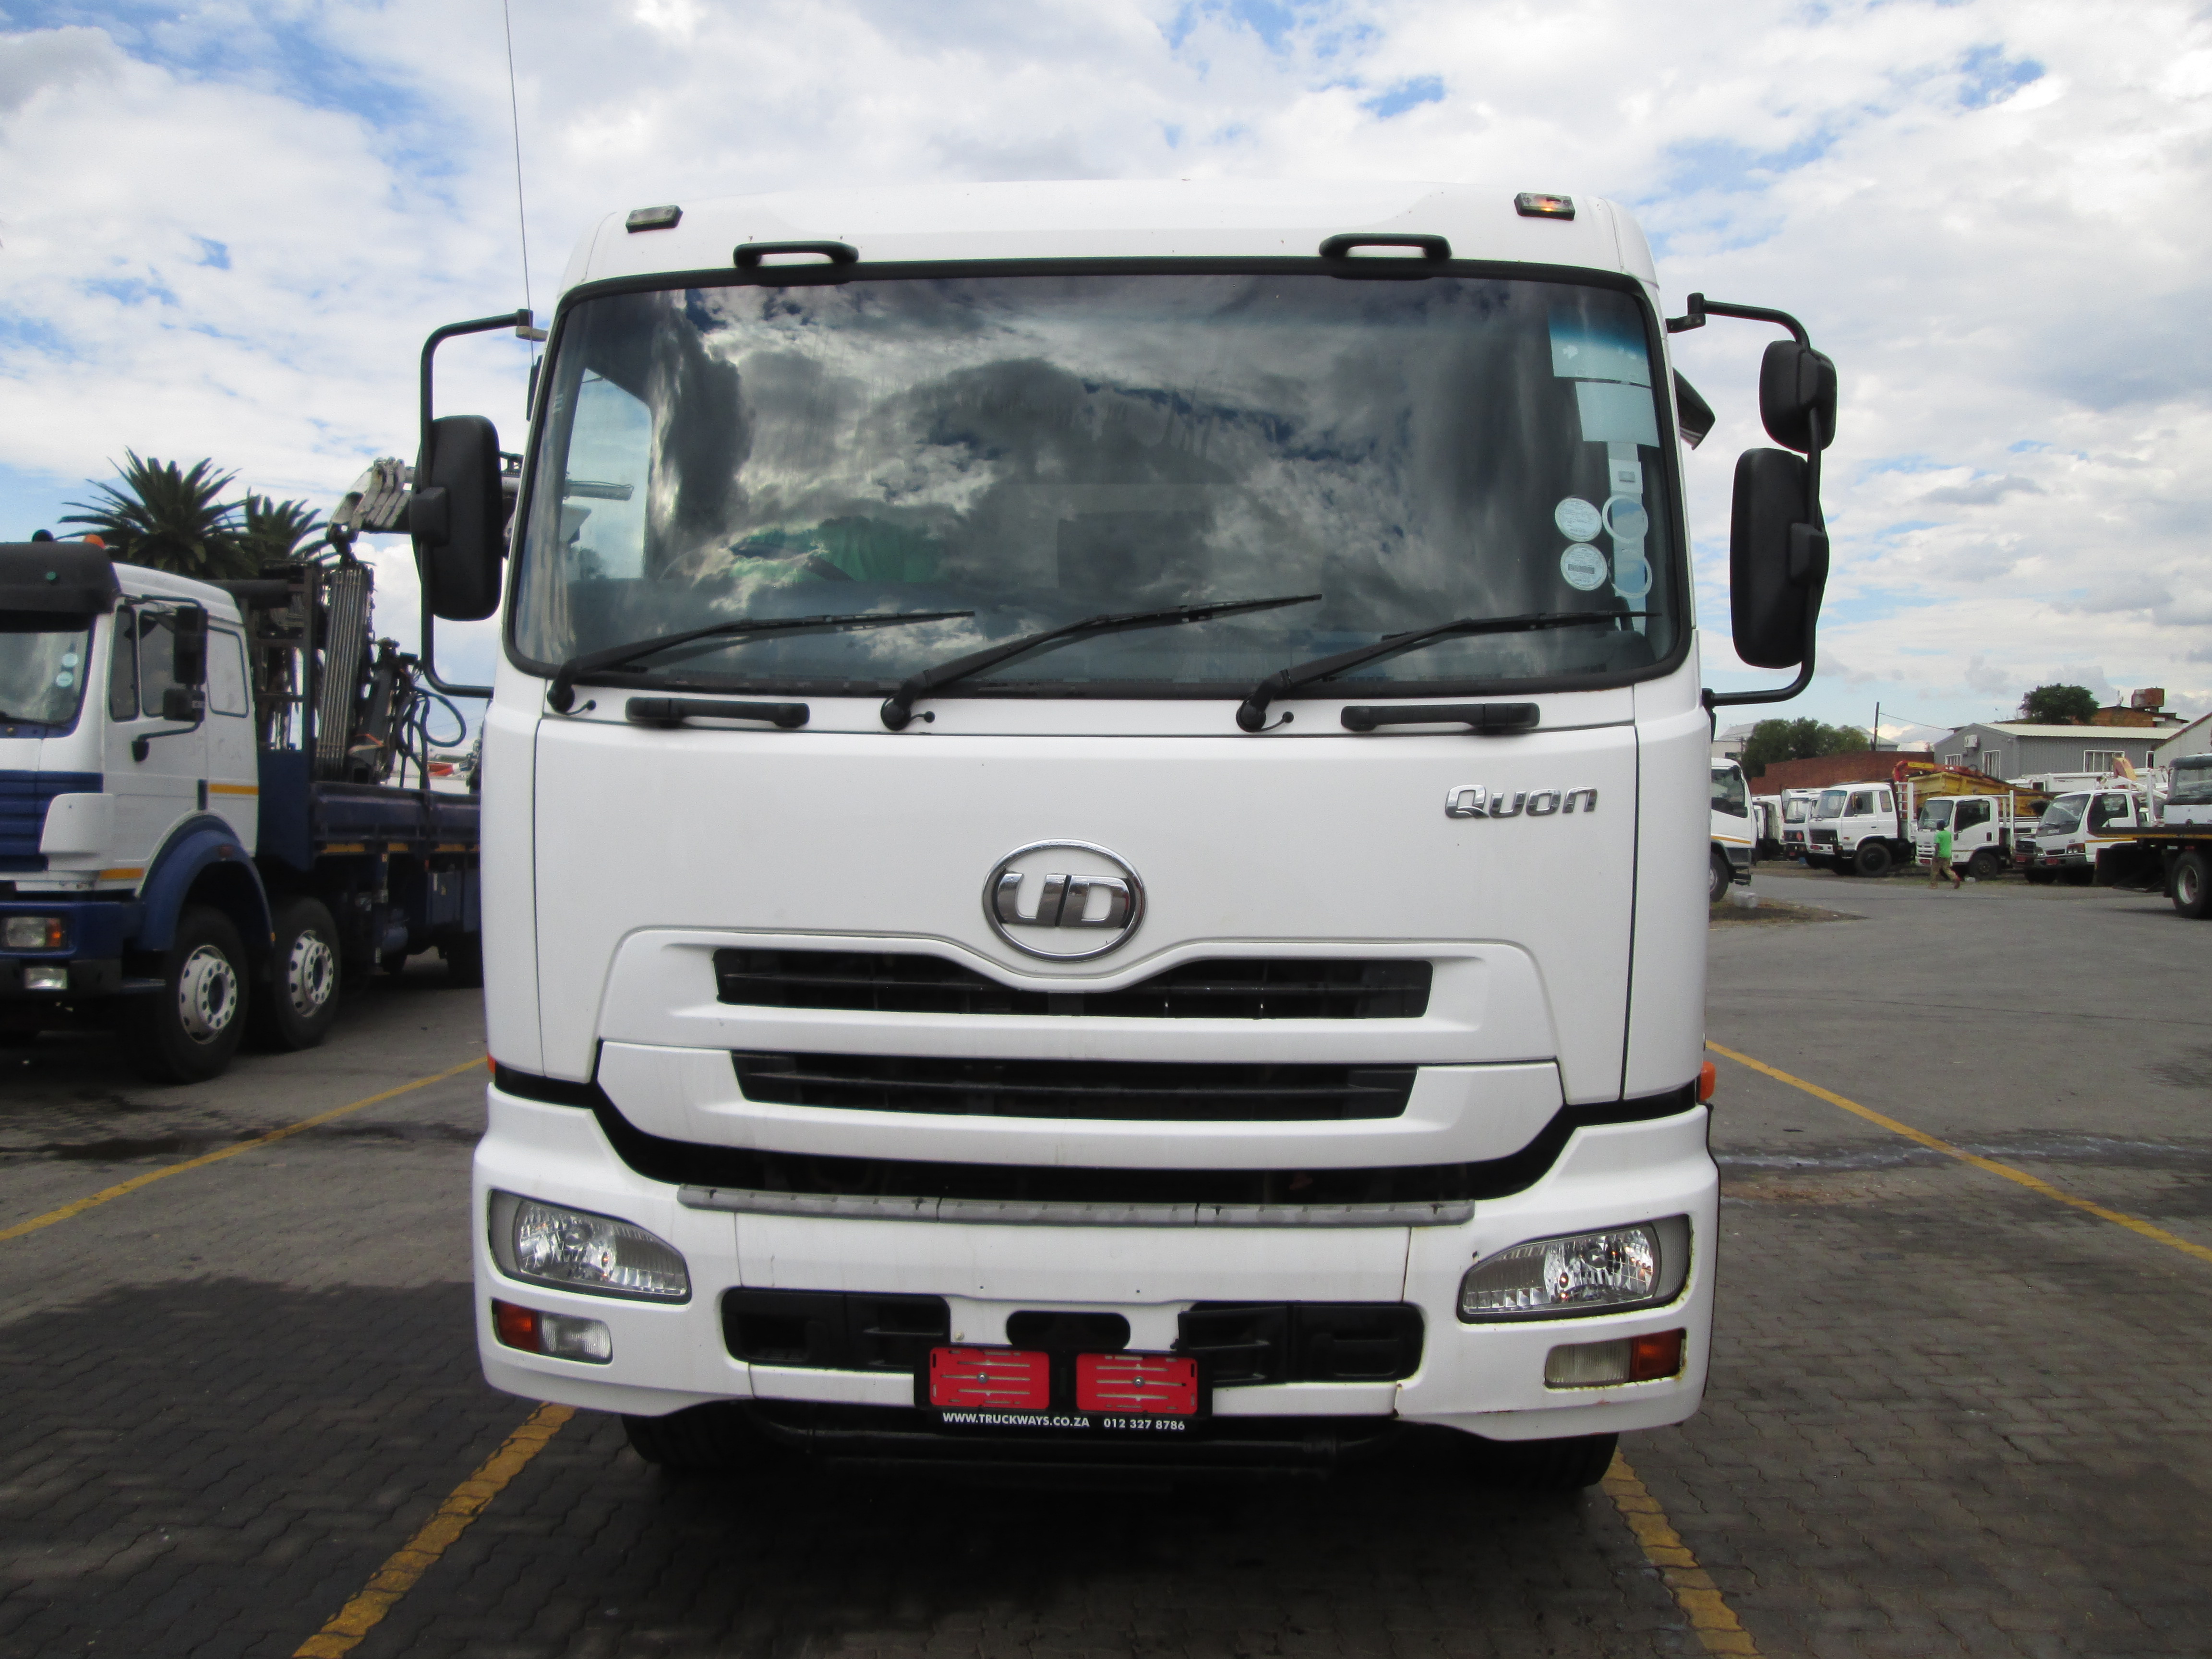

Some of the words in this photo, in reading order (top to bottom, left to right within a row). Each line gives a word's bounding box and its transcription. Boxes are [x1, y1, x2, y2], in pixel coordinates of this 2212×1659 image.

[1445, 783, 1598, 818] Quon
[998, 873, 1130, 929] UD
[943, 1412, 1090, 1427] WWW.TRUCKWAYS.CO.ZA
[1104, 1418, 1126, 1428] 012
[1130, 1419, 1152, 1429] 327
[1155, 1420, 1185, 1431] 8786
